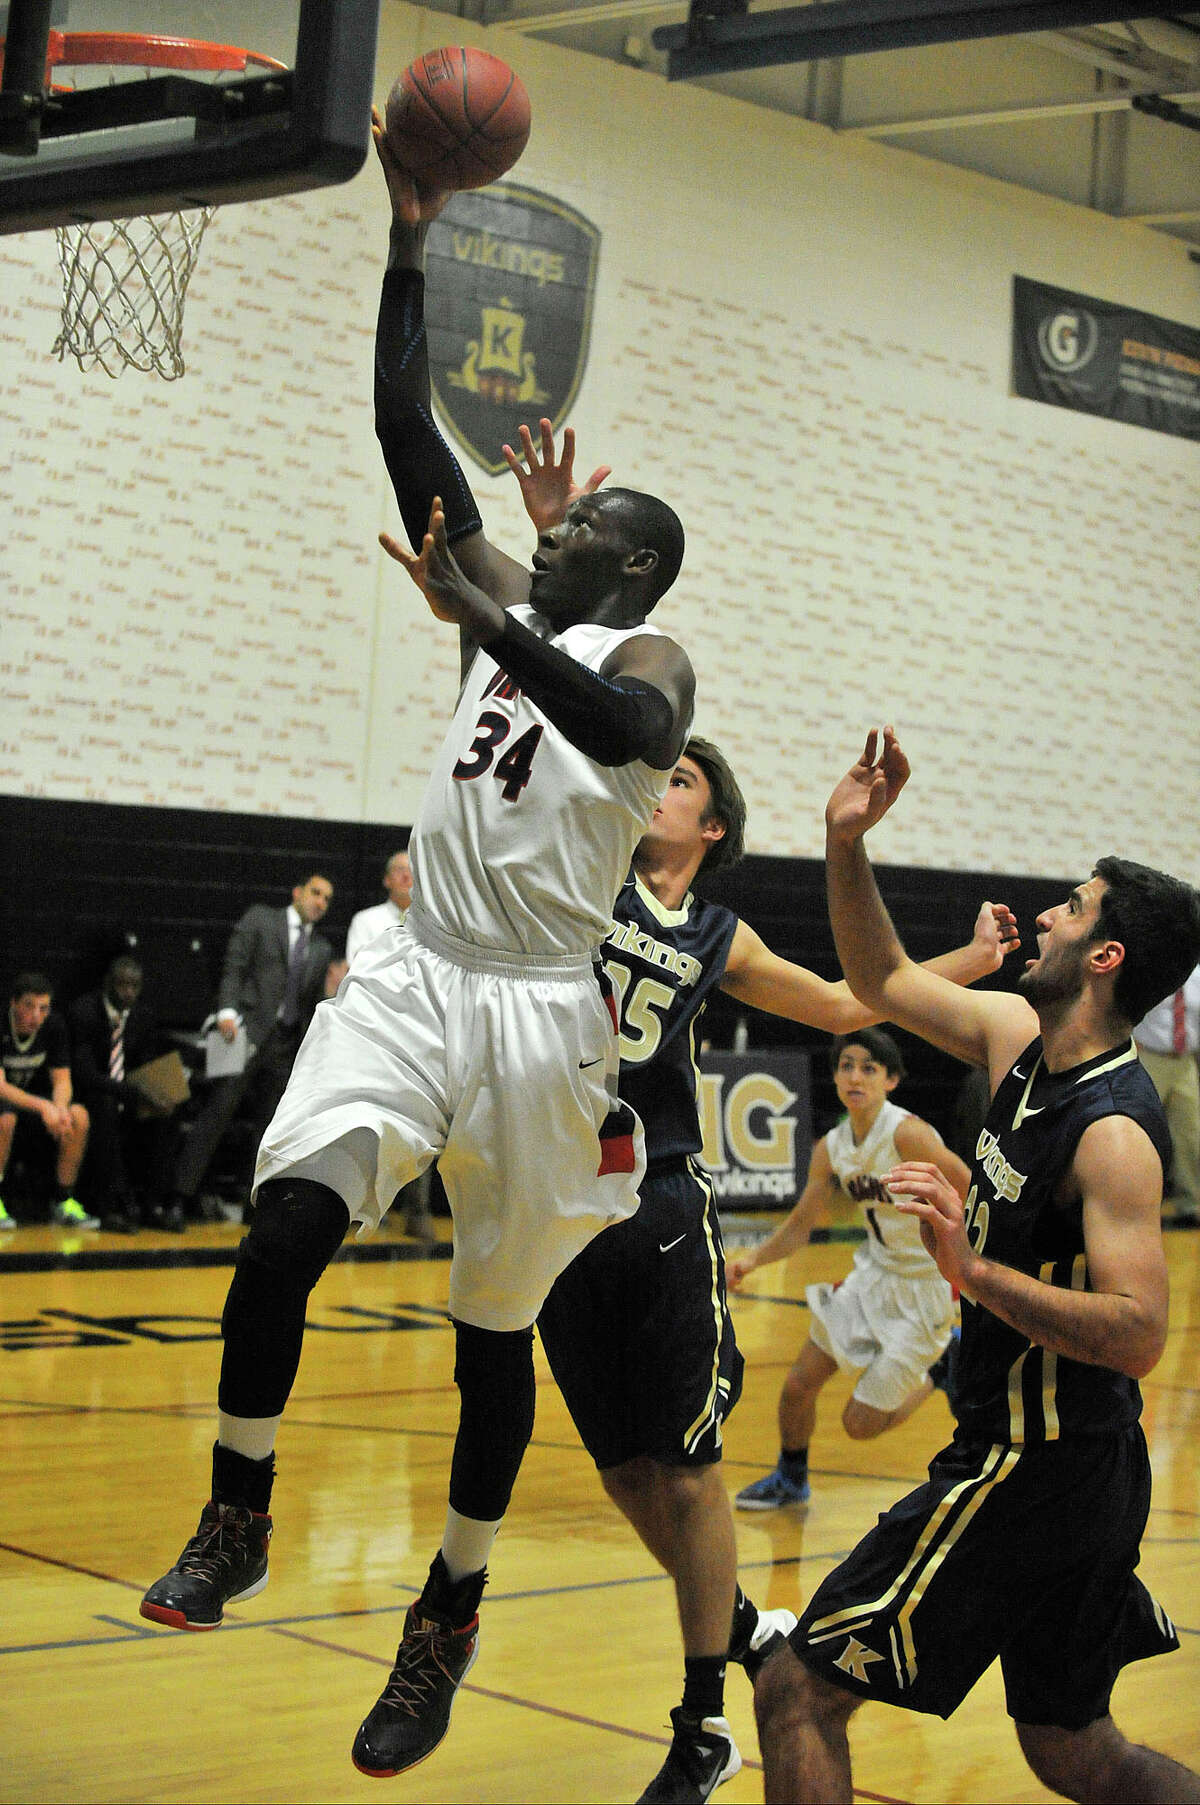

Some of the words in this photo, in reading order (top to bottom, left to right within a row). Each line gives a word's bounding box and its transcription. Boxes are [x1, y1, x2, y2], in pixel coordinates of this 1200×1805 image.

[489, 325, 512, 358] K
[1051, 314, 1078, 363] G
[452, 711, 544, 802] 34
[866, 1208, 887, 1248] 1
[832, 1635, 886, 1684] K
